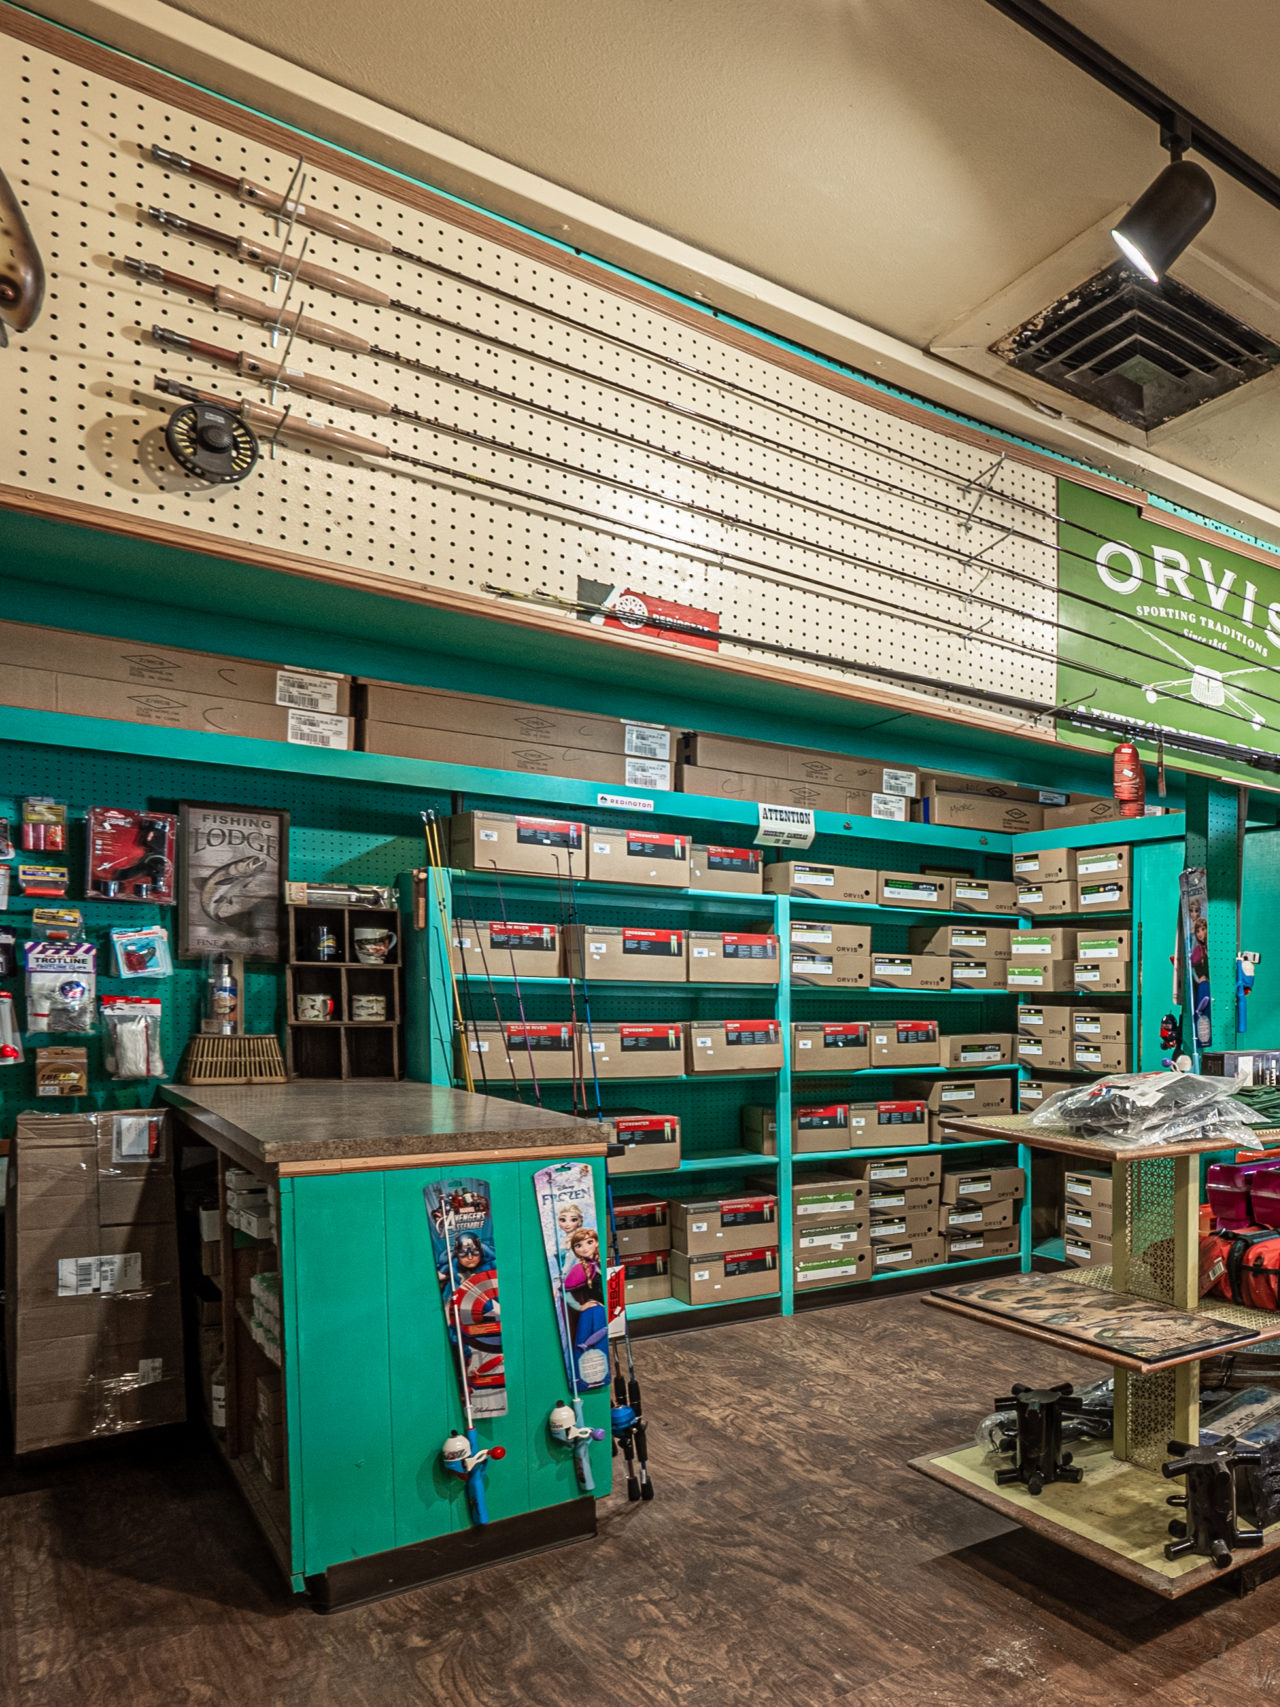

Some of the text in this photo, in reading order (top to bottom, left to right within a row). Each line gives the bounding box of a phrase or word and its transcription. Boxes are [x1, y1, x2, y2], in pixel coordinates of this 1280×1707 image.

[1135, 605, 1269, 658] SPORTING TRADITIONS
[202, 813, 272, 829] FISHING
[762, 807, 811, 825] ATTENTION
[193, 827, 279, 863] LODGE
[843, 891, 865, 900] ORVIS
[836, 945, 858, 953] ORVIS
[33, 956, 89, 965] TROTLINE
[836, 976, 858, 984] ORVIS
